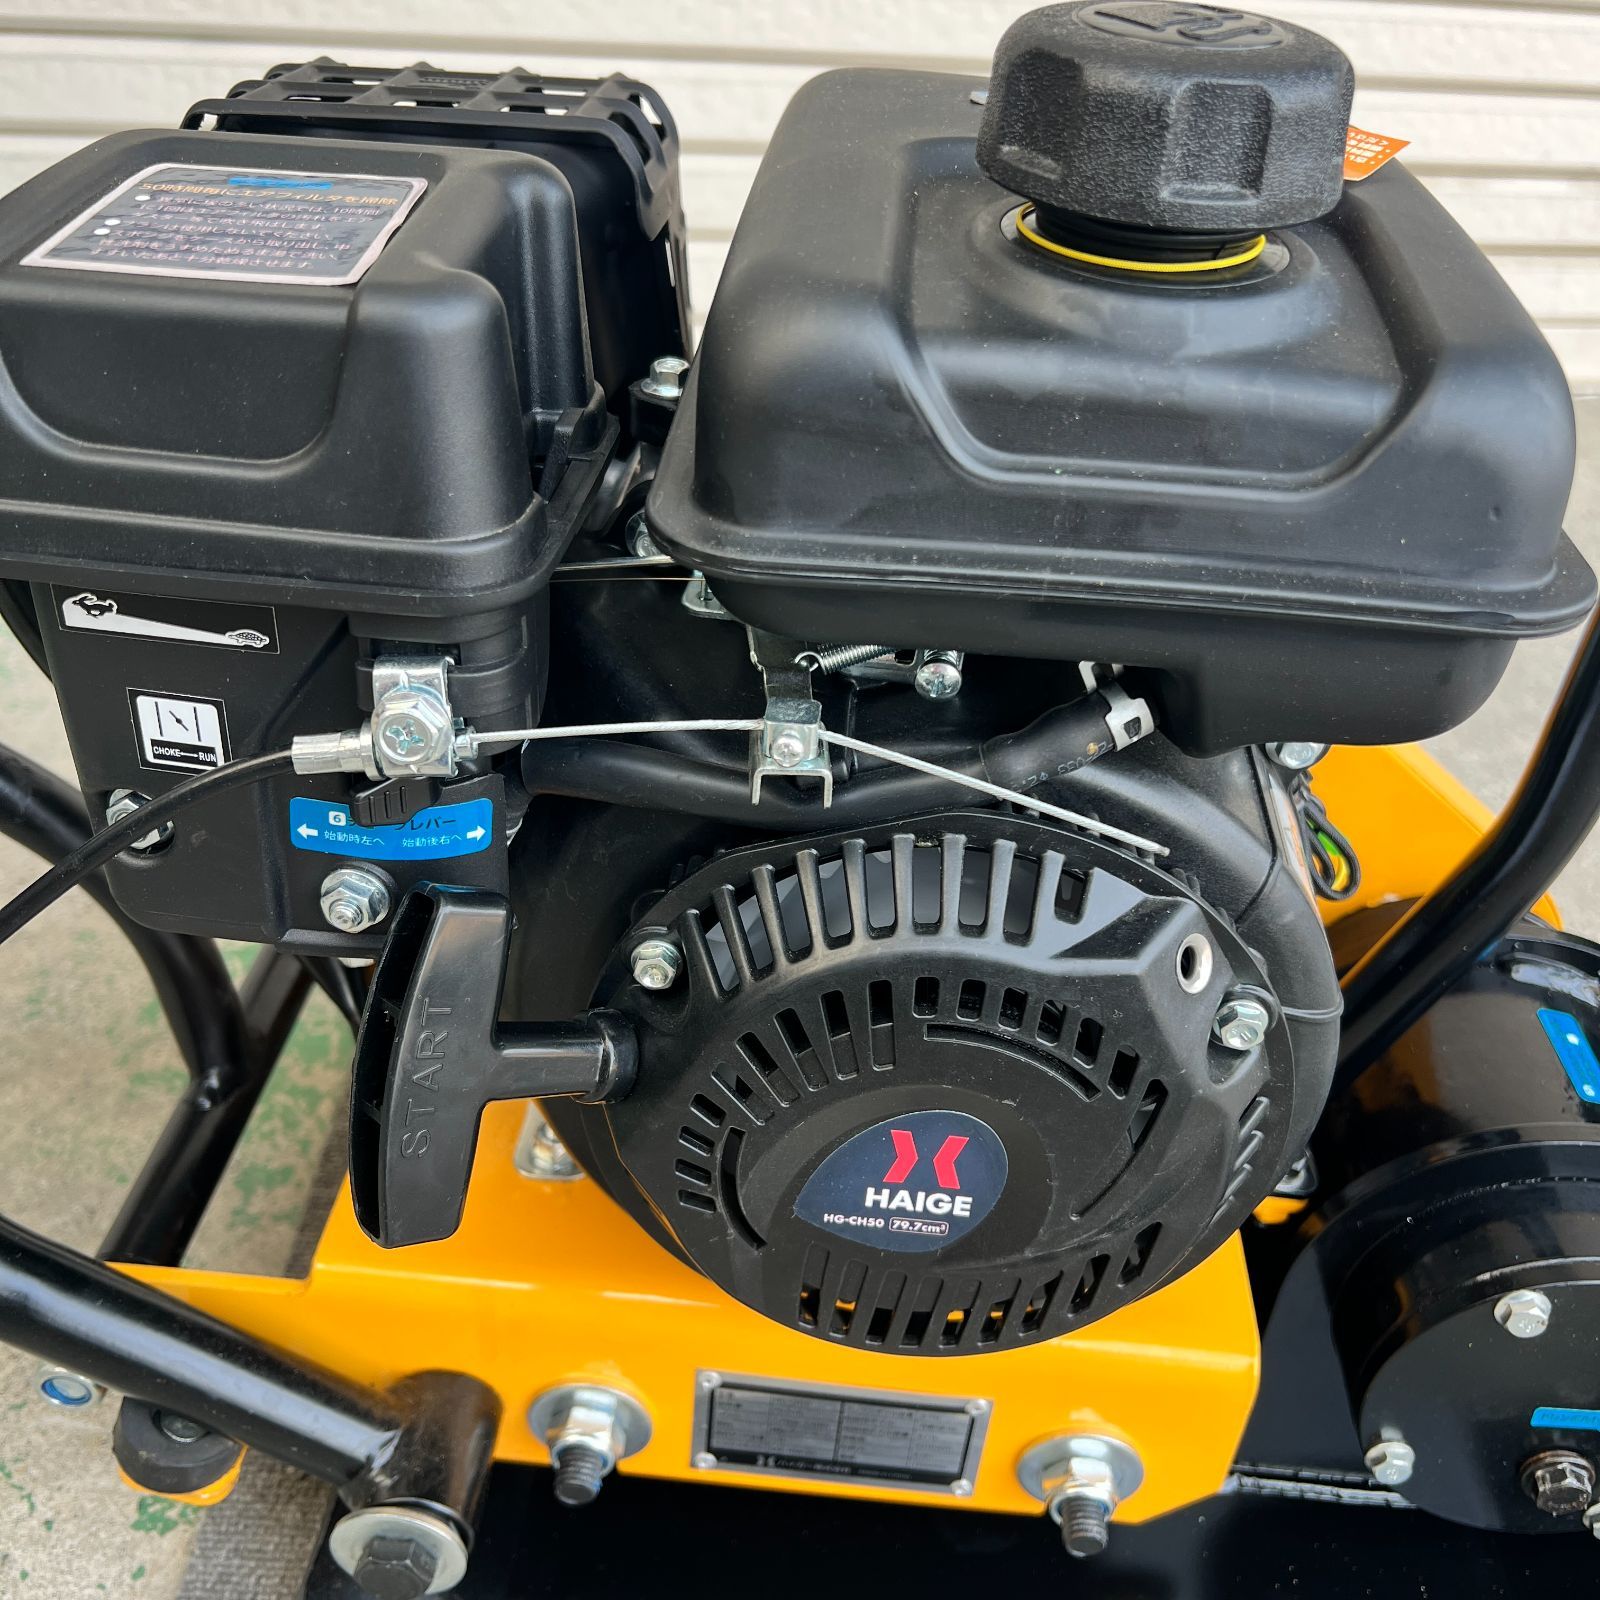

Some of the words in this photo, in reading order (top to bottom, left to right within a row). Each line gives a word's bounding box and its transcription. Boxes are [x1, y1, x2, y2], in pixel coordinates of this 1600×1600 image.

[153, 746, 181, 758] CHOKE
[199, 752, 217, 763] RUN
[324, 830, 385, 846] 始動時左へ
[402, 834, 462, 848] 始動後右へ
[401, 997, 452, 1158] START
[864, 1187, 973, 1218] HAIGE
[823, 1213, 885, 1228] HG-CH50
